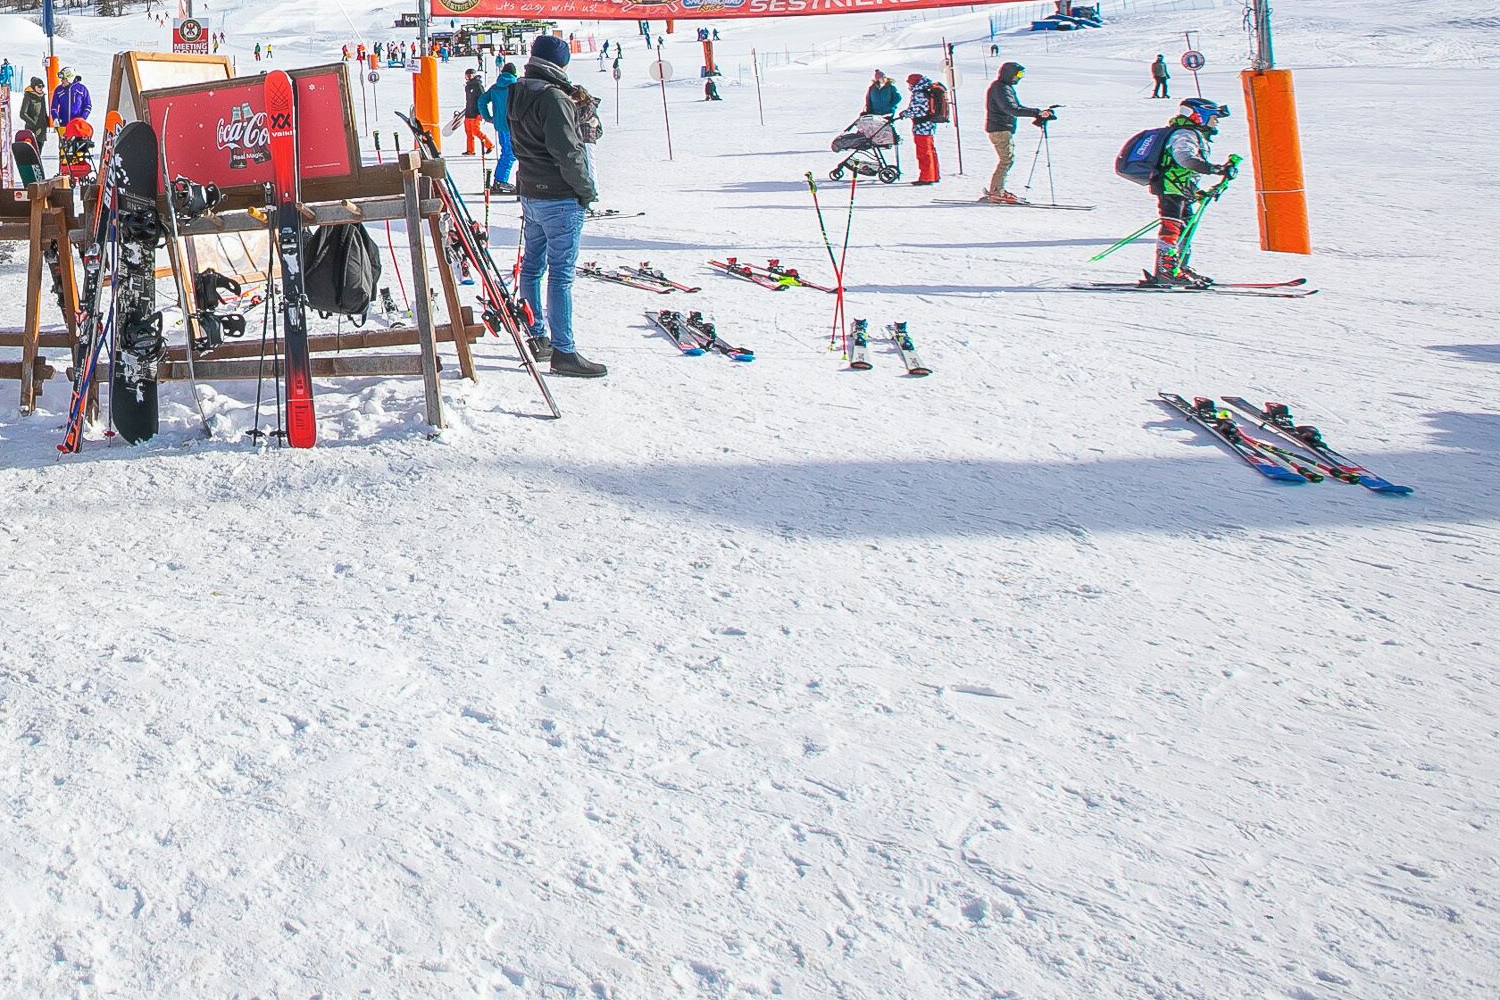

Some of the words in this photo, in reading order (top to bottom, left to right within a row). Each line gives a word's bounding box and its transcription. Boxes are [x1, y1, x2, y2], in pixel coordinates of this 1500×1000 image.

[520, 4, 546, 15] easy
[551, 2, 576, 12] with
[580, 2, 598, 12] us!
[216, 112, 270, 150] Coca-Co
[246, 151, 263, 161] Magic
